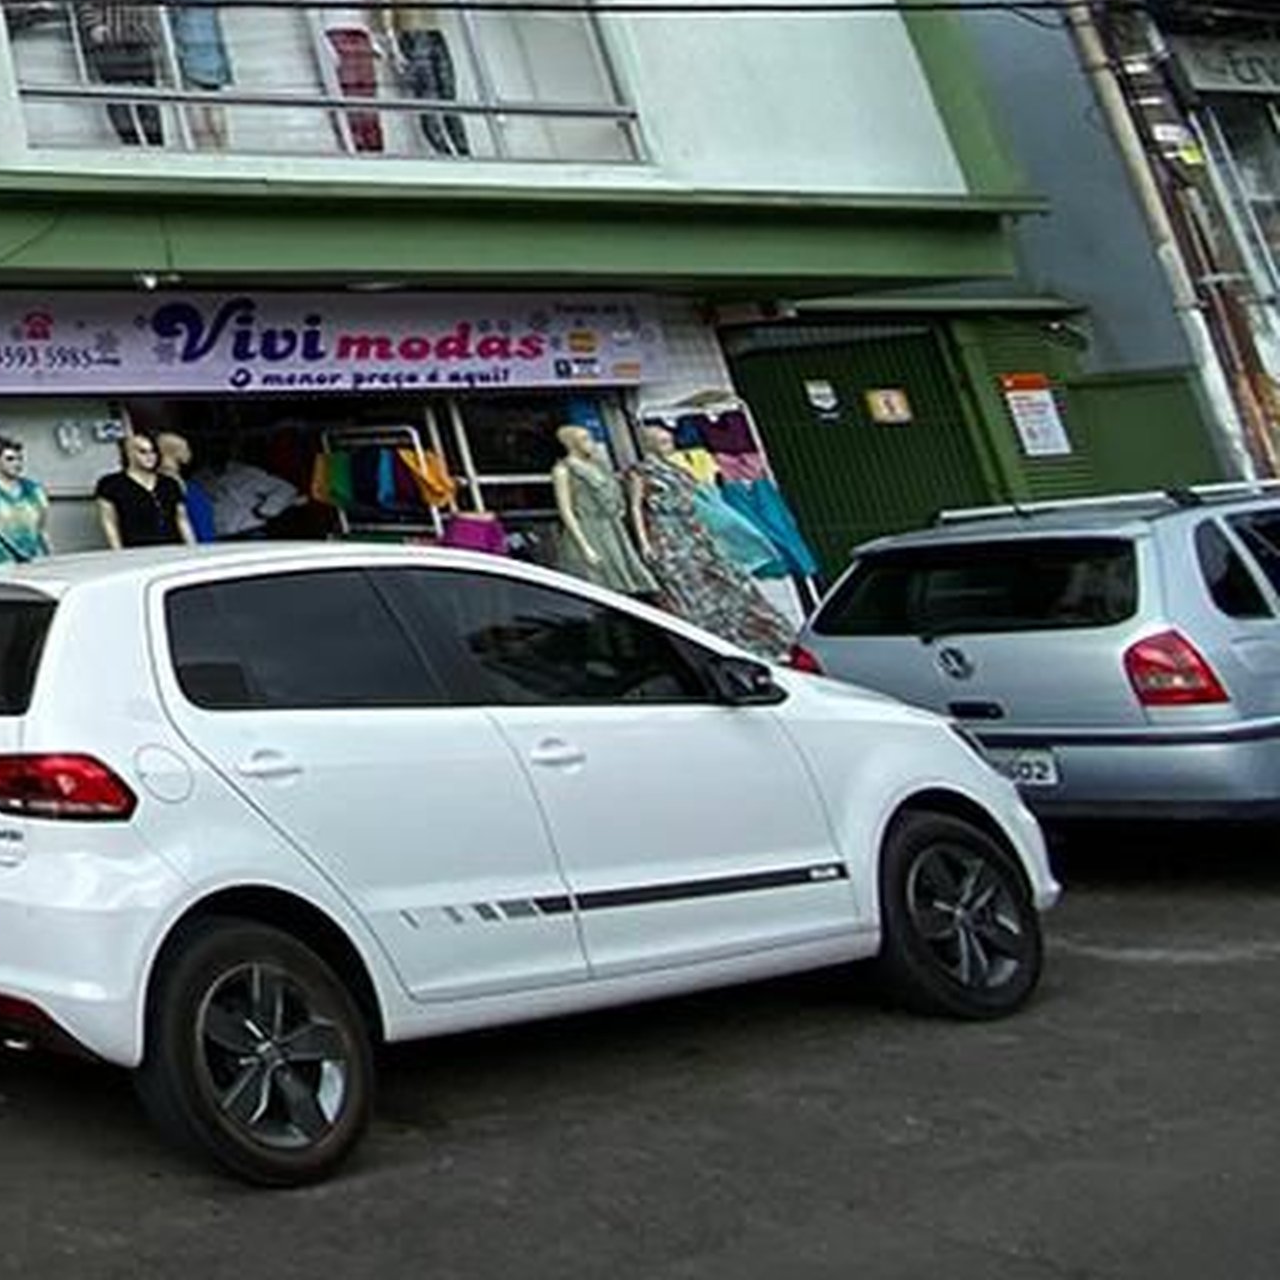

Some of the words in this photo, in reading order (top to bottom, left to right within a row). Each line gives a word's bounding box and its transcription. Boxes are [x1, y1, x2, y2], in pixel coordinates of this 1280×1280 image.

[152, 297, 328, 364] Vivi
[337, 322, 544, 360] modas
[230, 367, 253, 388] O
[262, 371, 341, 386] menor
